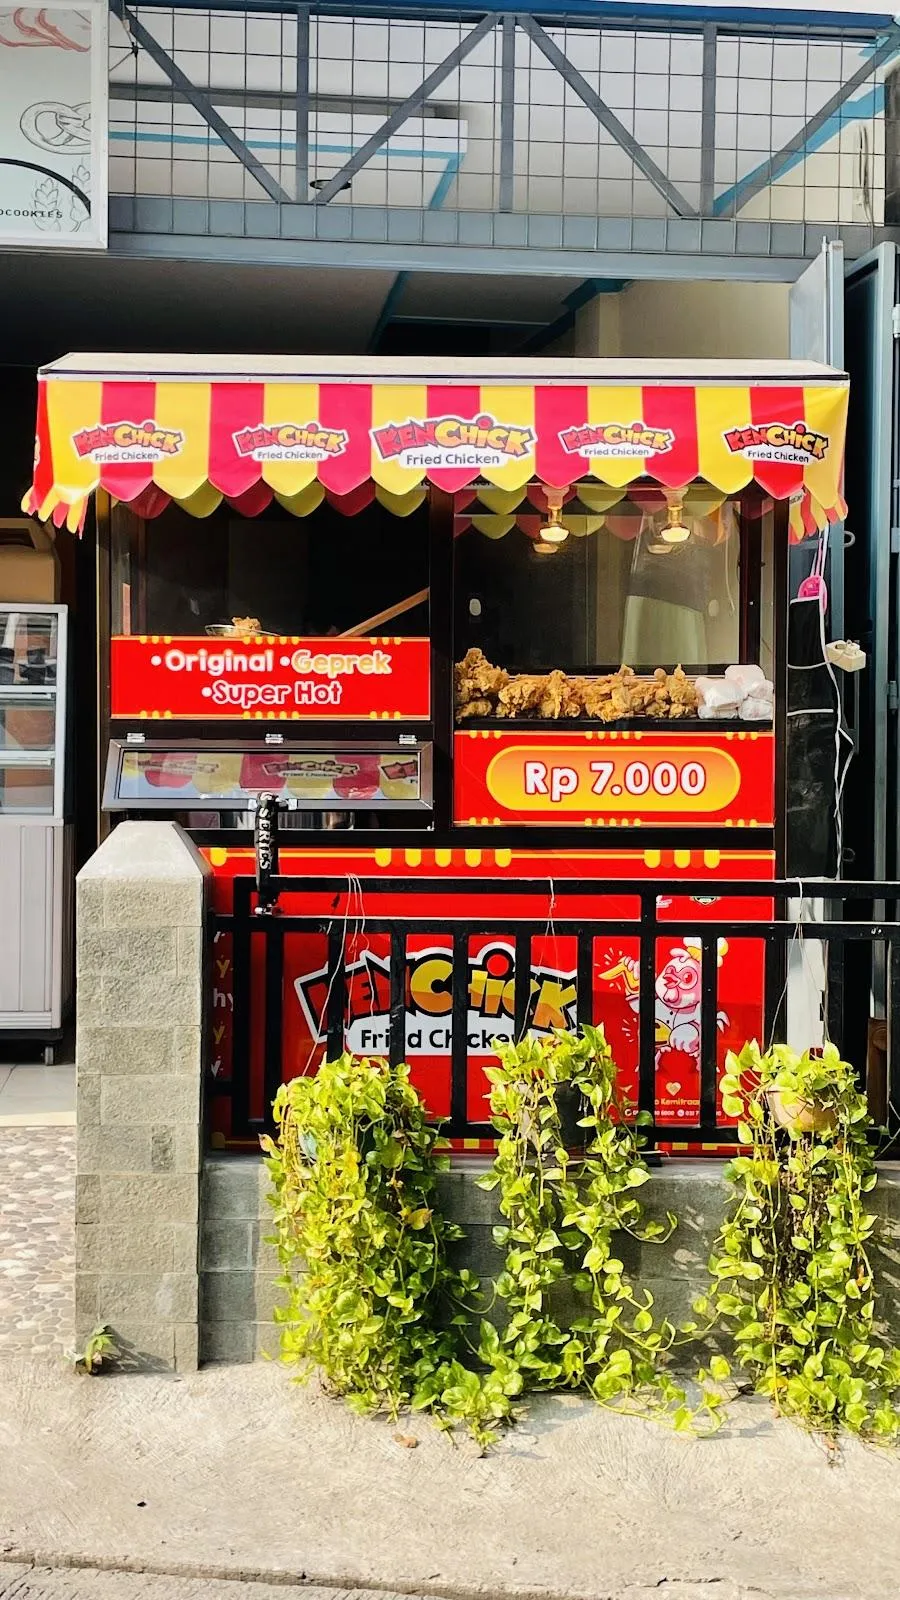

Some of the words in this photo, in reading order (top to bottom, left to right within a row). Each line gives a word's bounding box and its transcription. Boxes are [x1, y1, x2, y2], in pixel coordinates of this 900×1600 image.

[95, 453, 119, 461] Fried
[121, 452, 159, 460] Chicken
[258, 451, 282, 459] Fried
[285, 451, 323, 459] Chicken
[584, 448, 609, 456] Fried
[611, 448, 649, 456] Chicken
[748, 450, 772, 459] Fried
[774, 451, 809, 463] Chicken
[406, 454, 442, 465] Fried
[445, 453, 500, 465] Chicken
[165, 648, 274, 676] Original
[292, 649, 392, 679] Geprek
[212, 679, 291, 709] Super
[294, 680, 342, 704] Hot
[524, 760, 579, 802] Rp
[589, 760, 706, 796] 7.000
[361, 1029, 422, 1048] Frid
[429, 1029, 516, 1049] Chcke
